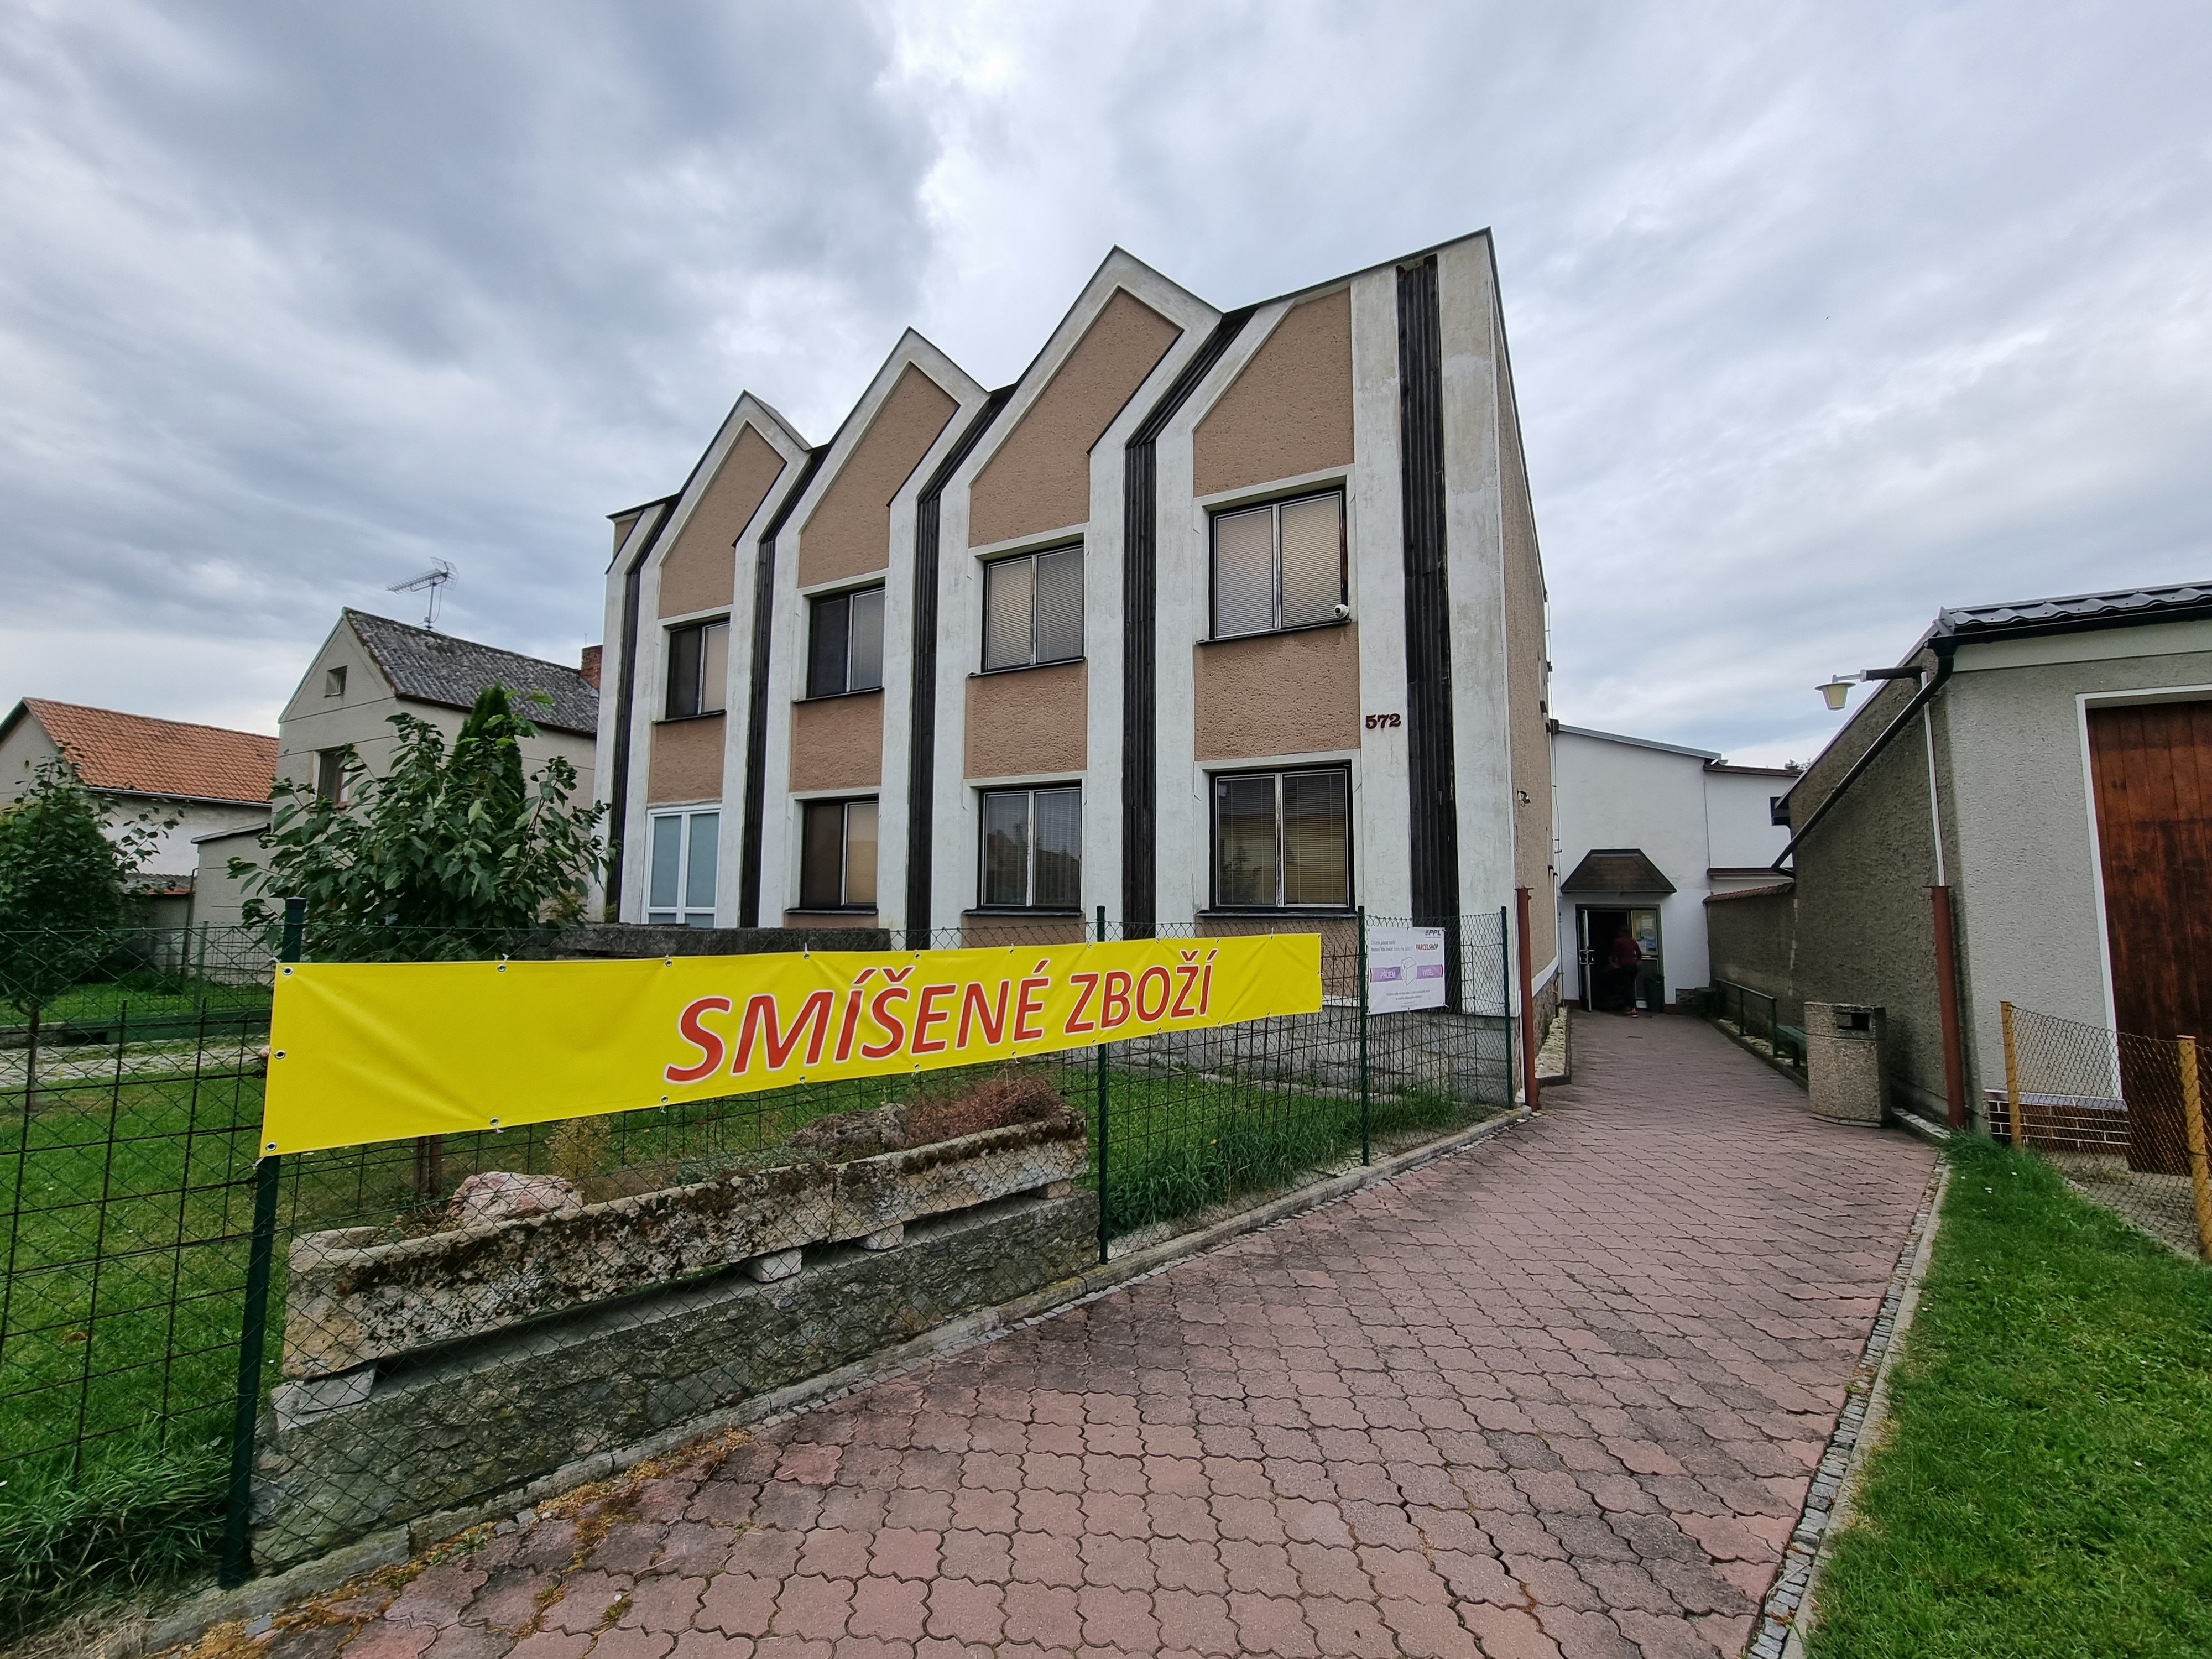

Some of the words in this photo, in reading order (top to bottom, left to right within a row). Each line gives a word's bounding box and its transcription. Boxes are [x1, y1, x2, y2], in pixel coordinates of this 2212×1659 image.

[1365, 713, 1401, 729] 572
[665, 959, 1050, 1082] SMÍŠENÉ
[1065, 948, 1219, 1034] ZBOŽÍ
